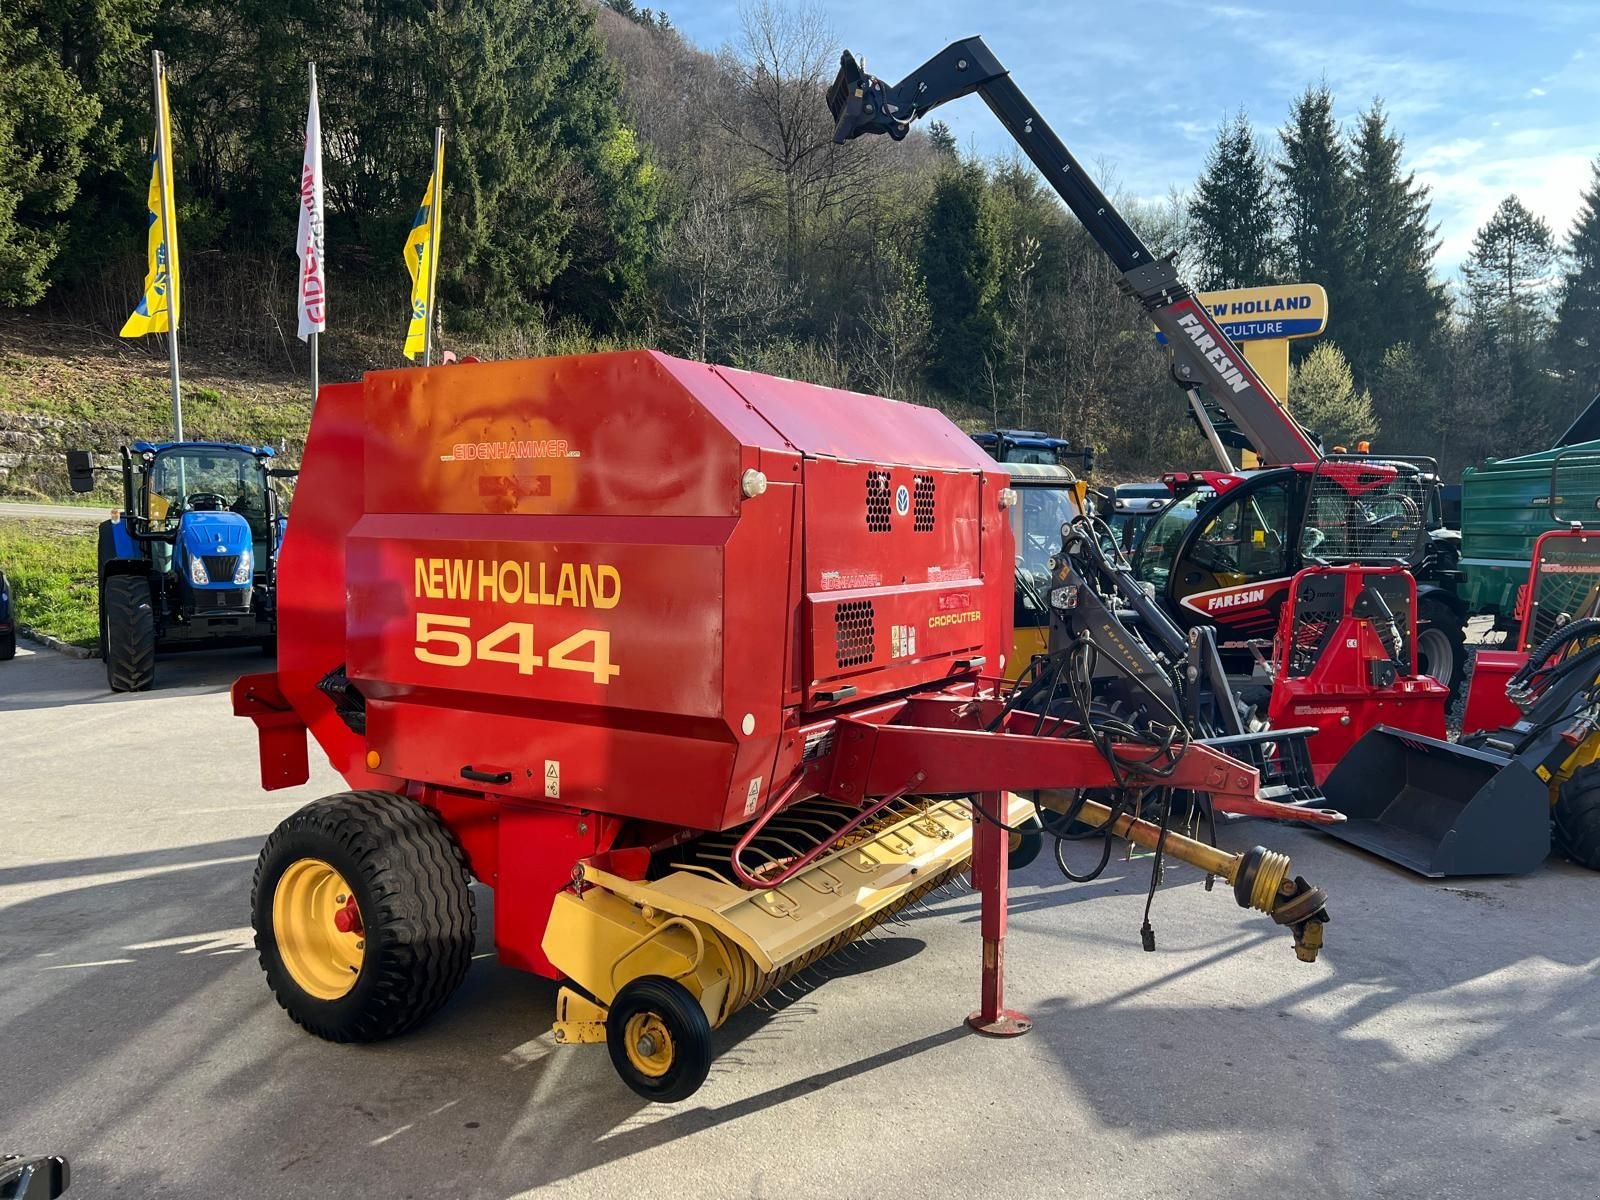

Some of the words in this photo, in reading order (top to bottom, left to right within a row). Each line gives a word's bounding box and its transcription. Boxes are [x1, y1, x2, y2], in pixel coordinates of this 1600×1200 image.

[1204, 303, 1228, 317] EW
[1231, 296, 1312, 315] HOLLAND
[1223, 322, 1283, 337] CULTURE
[1177, 312, 1251, 394] FARESIN
[415, 557, 473, 599] NEW
[478, 559, 621, 608] HOLLAND
[1207, 589, 1265, 611] FARESIN
[928, 610, 981, 629] CROPCUTTER
[414, 612, 621, 685] 544
